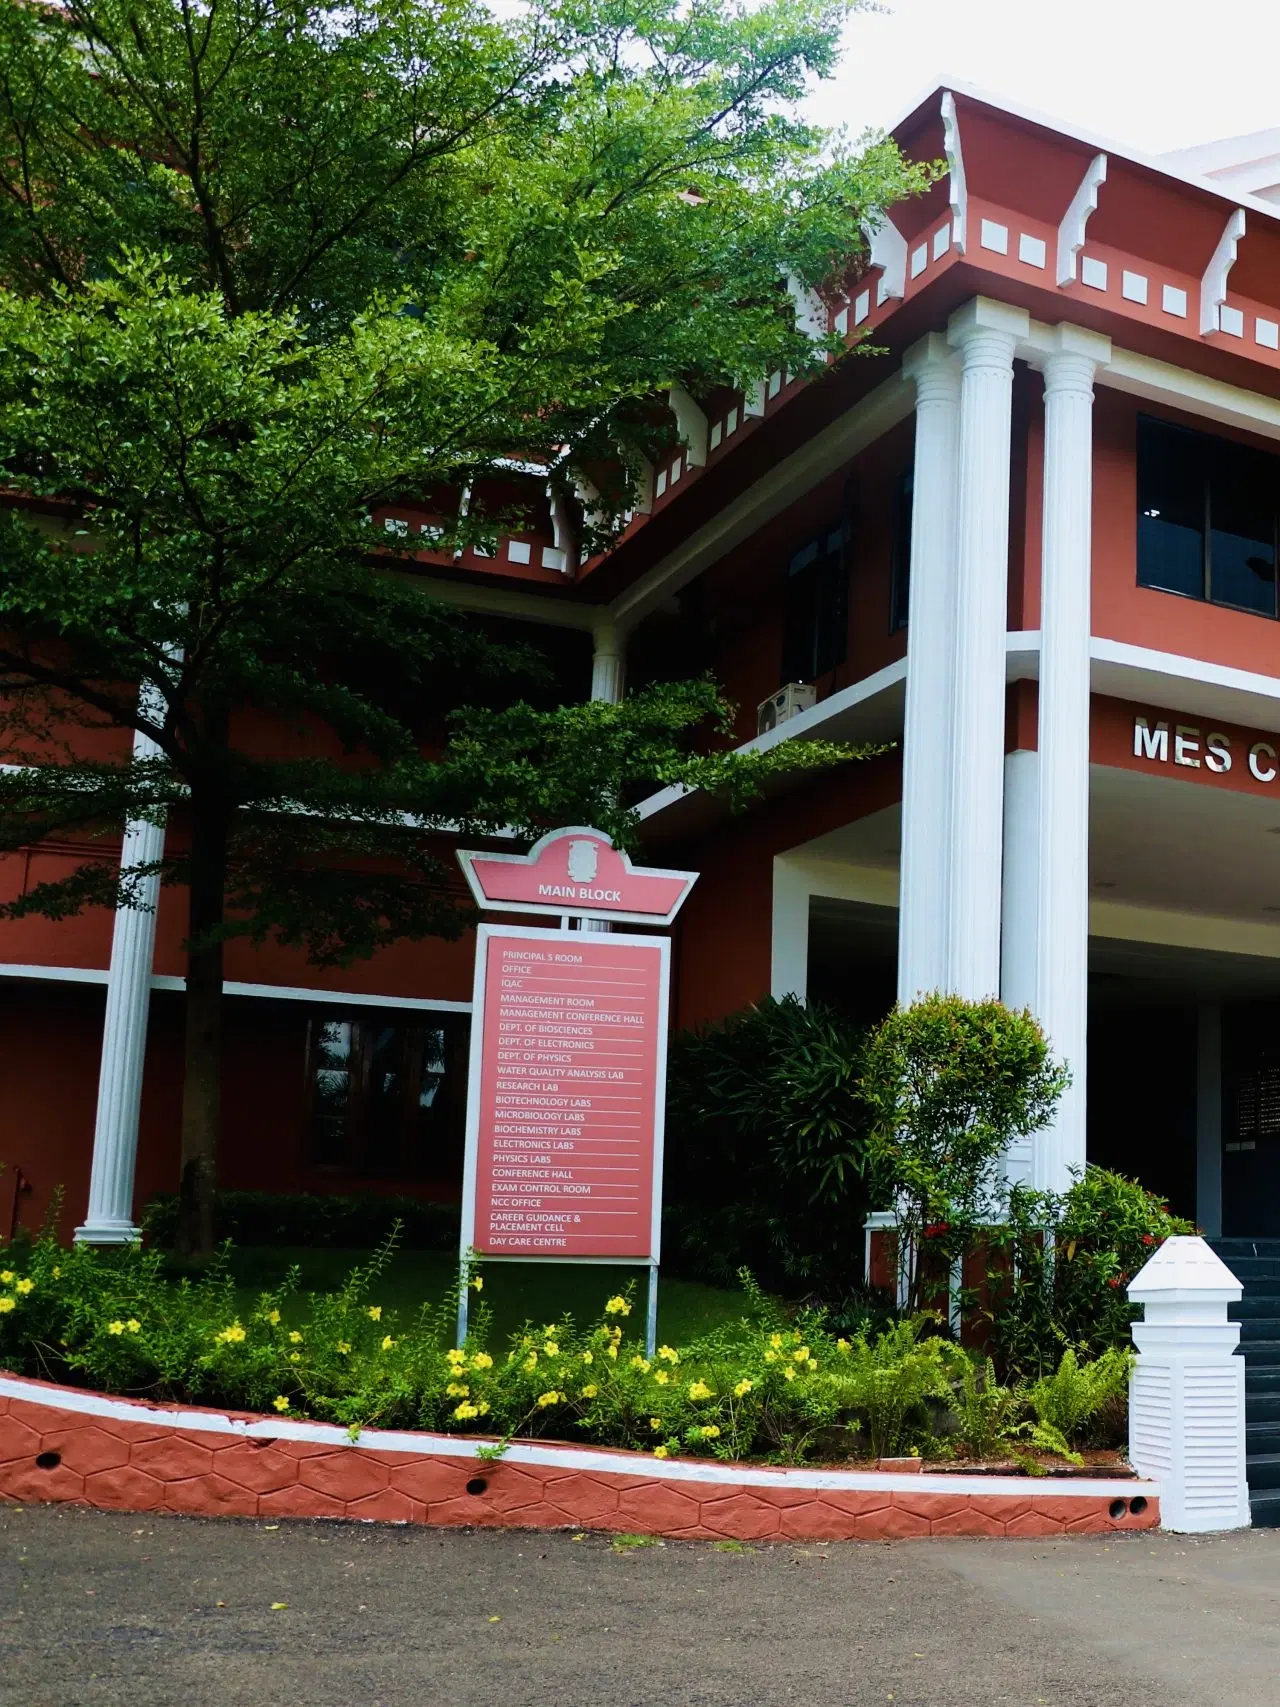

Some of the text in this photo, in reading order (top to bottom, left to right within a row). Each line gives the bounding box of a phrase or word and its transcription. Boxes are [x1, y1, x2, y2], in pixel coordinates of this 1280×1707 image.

[1134, 716, 1232, 773] MES
[539, 884, 620, 902] MAIN BLOCK
[555, 954, 582, 963] ROOM
[502, 964, 532, 974] OFFICE
[502, 980, 522, 988] IQAC
[501, 995, 594, 1007] MANAGEMENT ROOM
[500, 1009, 565, 1019] MANAGEMENT
[566, 1013, 621, 1022] CONFERENCE
[500, 1023, 522, 1031] DEPT.
[539, 1025, 592, 1035] BIOSCIENCES
[499, 1038, 522, 1046] DEPT.
[538, 1039, 594, 1049] ELECTRONICS
[538, 1054, 572, 1063] PHYSICS
[497, 1066, 623, 1079] WATER QUALITY ANALYSIS LAB
[496, 1081, 558, 1091] RESEARCH LAB
[496, 1096, 591, 1107] BIOTECHNOLOGY LABS
[495, 1110, 585, 1121] MICROBIOLOGY LABS
[495, 1125, 558, 1135] BIOCHEMISTRY
[494, 1139, 574, 1149] ELECTRONICS LABS
[493, 1154, 551, 1164] PHYSICS LABS
[492, 1168, 573, 1178] CONFERENCE HALL
[492, 1184, 591, 1194] EXAM CONTROL ROOM
[512, 1199, 541, 1207] OFFICE
[491, 1213, 524, 1221] CAREER
[526, 1214, 572, 1223] GUIDANCE
[490, 1223, 542, 1231] PLACEMENT
[534, 1238, 567, 1246] CENTRE
